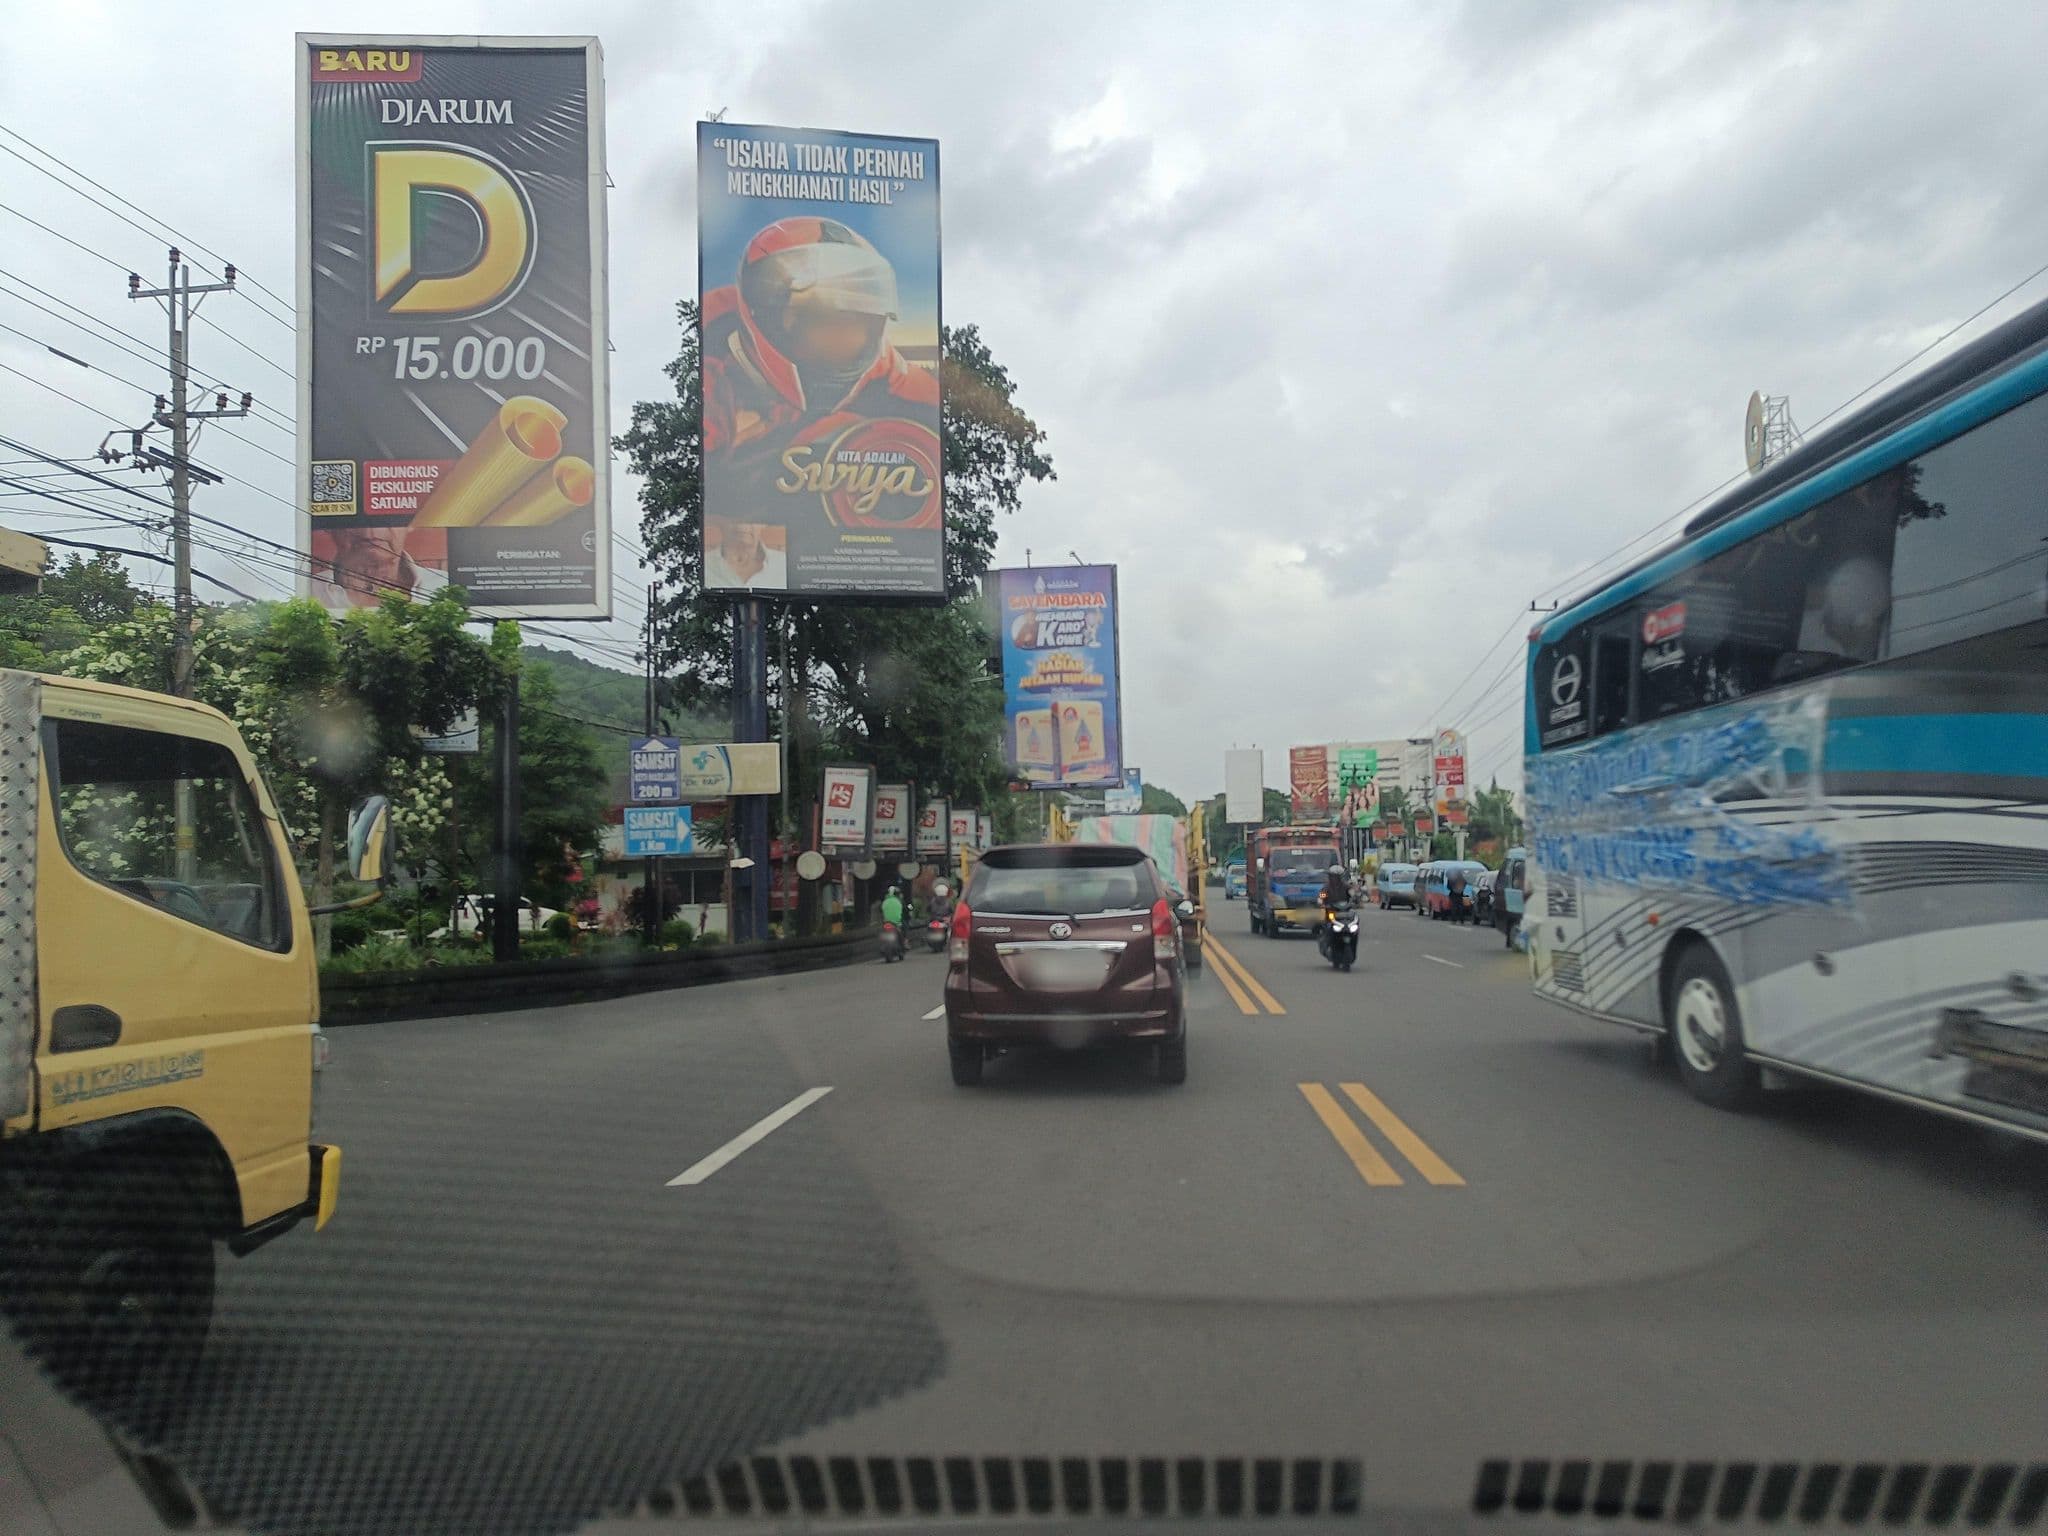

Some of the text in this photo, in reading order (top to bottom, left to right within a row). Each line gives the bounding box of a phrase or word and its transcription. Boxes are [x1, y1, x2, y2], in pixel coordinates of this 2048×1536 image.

[319, 50, 411, 72] BARU
[381, 98, 514, 127] DJARUM
[794, 143, 848, 175] TIDAK
[854, 147, 924, 180] PERNAH
[728, 171, 844, 201] MENGKHIANATI
[375, 150, 528, 314] D
[356, 336, 546, 381] RP 15.000
[837, 450, 906, 464] KITA ADALAH
[370, 465, 439, 479] DIBUNGKUS
[776, 446, 934, 515] Surya
[370, 481, 434, 494] EKSKLUSIF
[371, 496, 417, 509] SATUAN
[634, 753, 676, 770] SAMSAT
[639, 785, 660, 797] 200
[629, 811, 675, 829] SAMSAT
